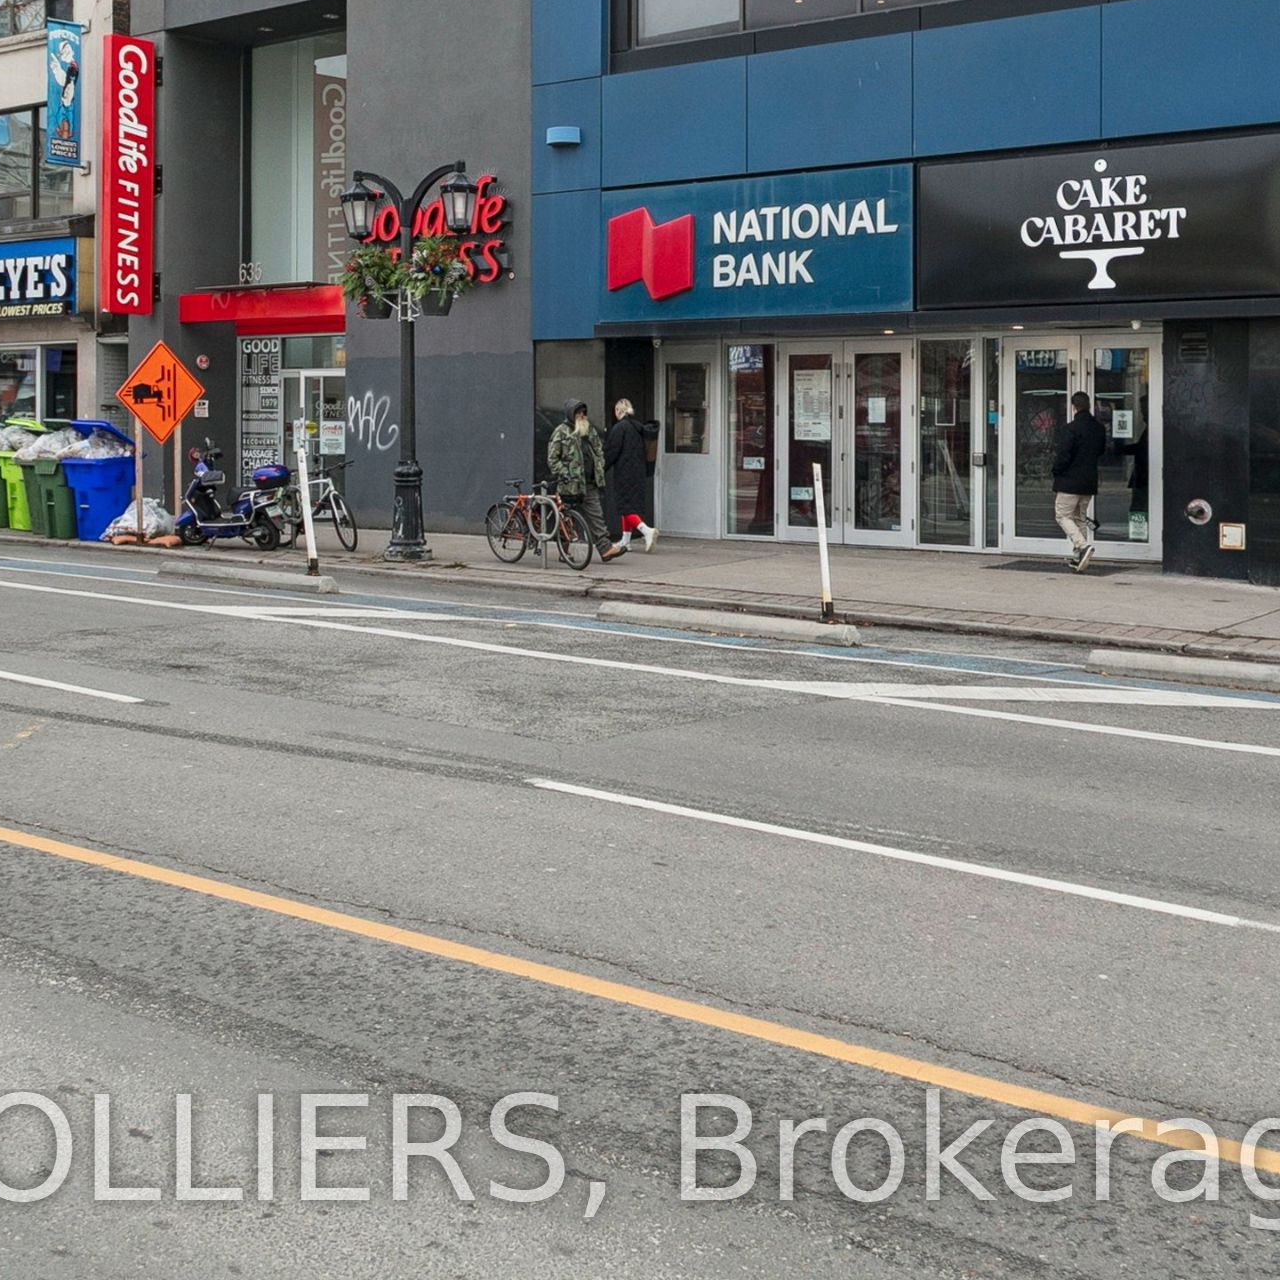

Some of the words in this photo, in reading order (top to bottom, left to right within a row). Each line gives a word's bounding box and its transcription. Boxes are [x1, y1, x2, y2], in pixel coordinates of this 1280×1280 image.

[118, 44, 148, 173] GoodLife
[1056, 174, 1147, 211] CAKE
[712, 198, 899, 244] NATIONAL
[1020, 207, 1187, 247] CABARET
[117, 178, 140, 307] FITNESS
[239, 262, 262, 281] 635
[712, 248, 814, 288] BANK
[32, 303, 63, 315] PRICES
[243, 339, 278, 353] GOOD
[243, 354, 279, 375] LIFE
[243, 375, 271, 384] FITNESS
[243, 449, 274, 458] MASSAGE
